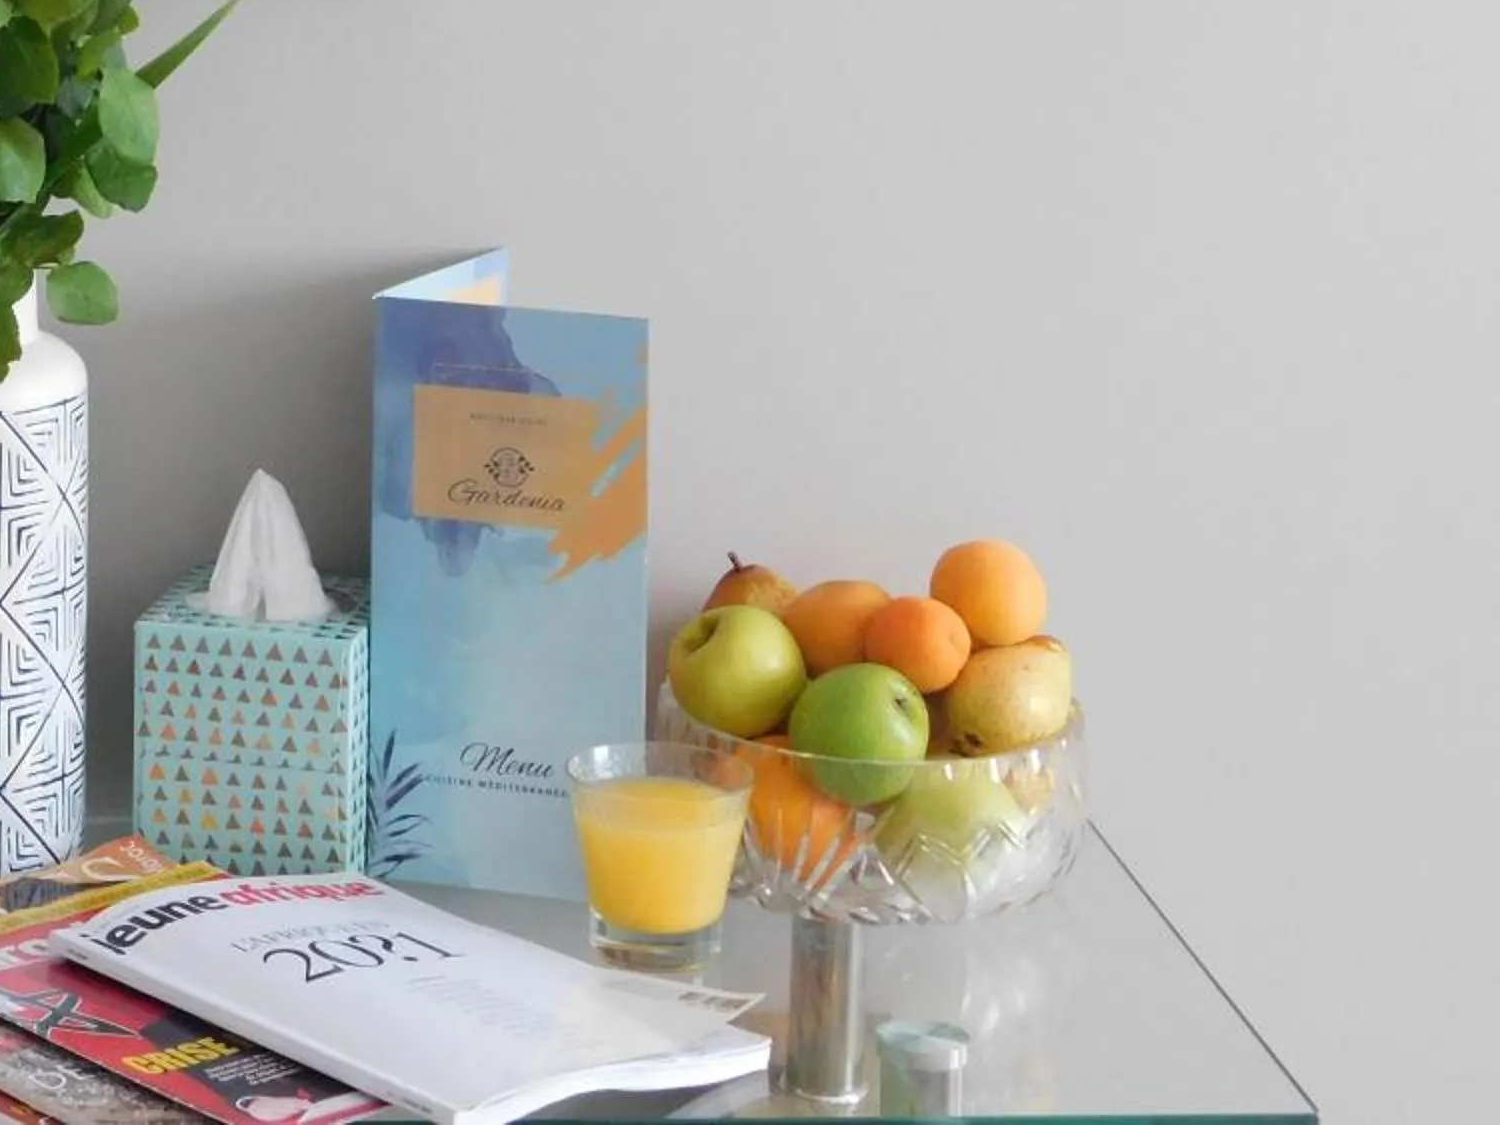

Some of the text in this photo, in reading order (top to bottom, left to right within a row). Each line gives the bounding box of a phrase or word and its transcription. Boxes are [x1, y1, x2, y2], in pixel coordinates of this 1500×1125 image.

[447, 477, 566, 513] Gardenia
[459, 741, 554, 779] Menu
[79, 879, 386, 956] jeune afrique
[121, 1035, 241, 1077] CRISE
